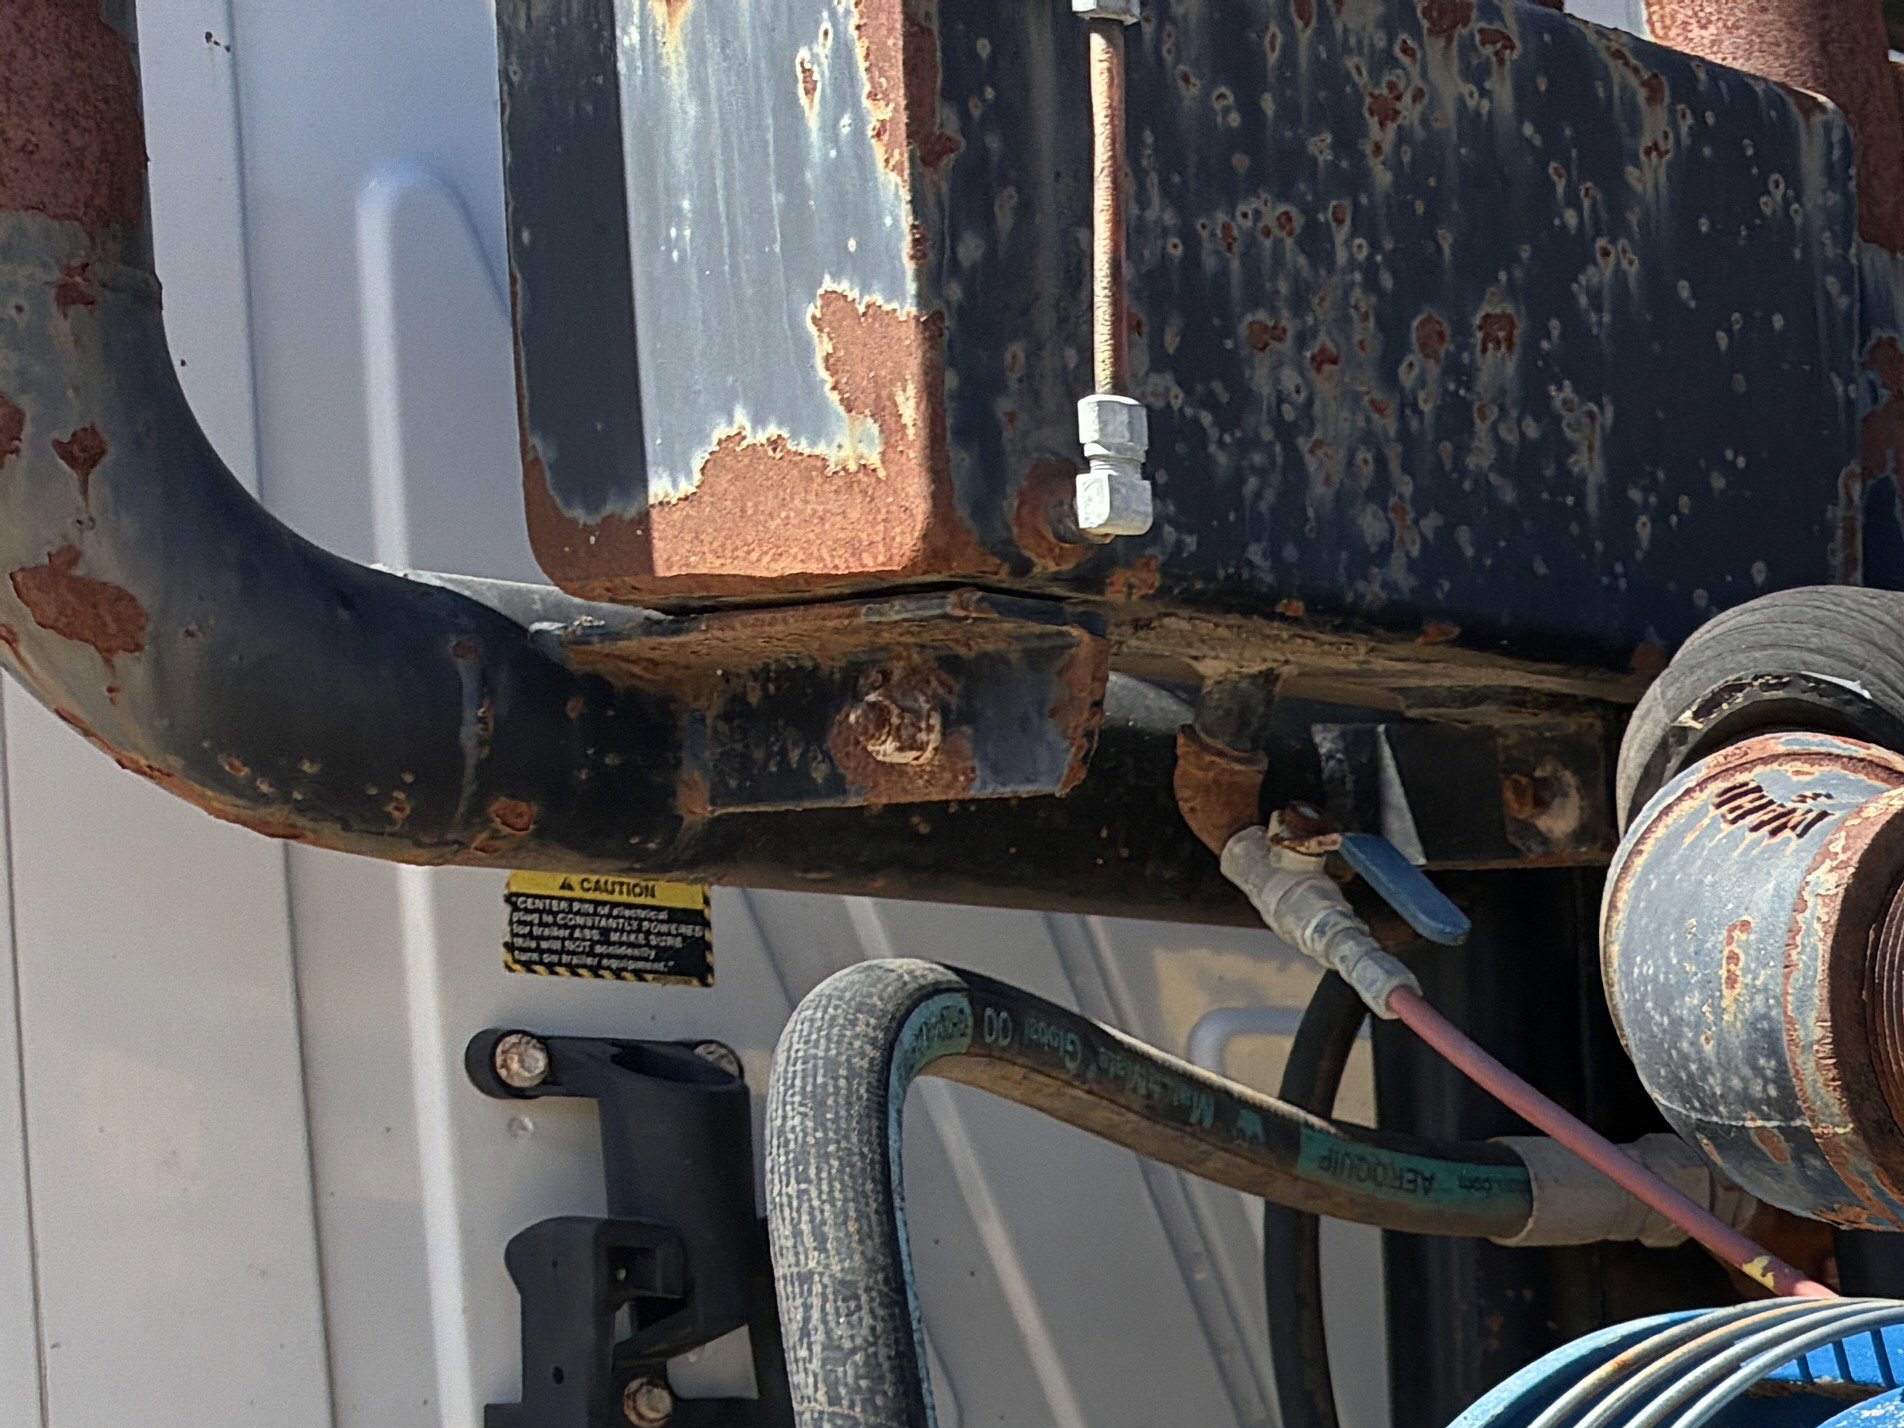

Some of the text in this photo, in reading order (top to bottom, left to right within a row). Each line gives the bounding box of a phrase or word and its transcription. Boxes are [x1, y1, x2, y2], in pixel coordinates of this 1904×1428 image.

[580, 877, 657, 899] CAUTION
[572, 901, 595, 914] PIN
[532, 924, 571, 938] trailer
[609, 931, 647, 945] MAKE
[648, 935, 683, 949] SURE
[556, 913, 639, 931] CONSTANTLY
[642, 921, 705, 938] POWERED
[564, 940, 592, 953] NOT
[1317, 1147, 1436, 1196] AEROQUIP
